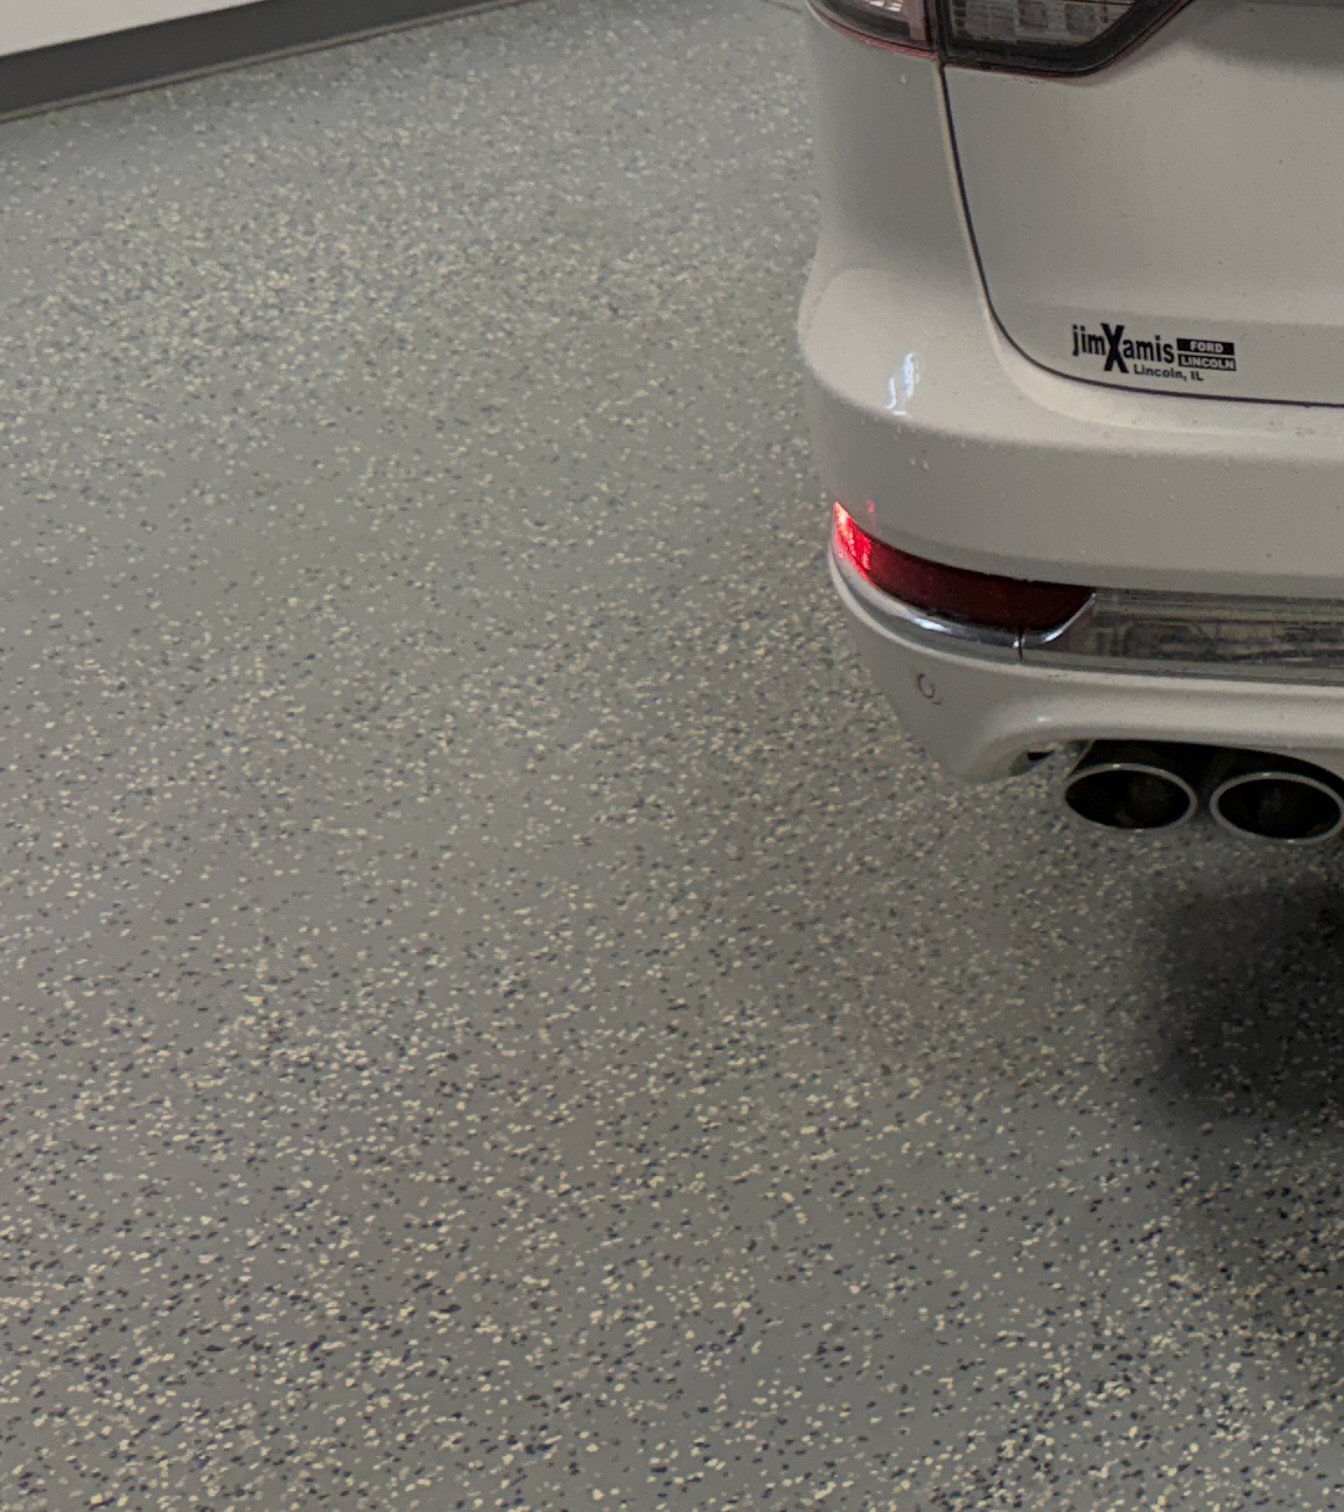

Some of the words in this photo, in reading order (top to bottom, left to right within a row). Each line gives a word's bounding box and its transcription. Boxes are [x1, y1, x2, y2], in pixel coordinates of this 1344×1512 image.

[1190, 342, 1224, 353] FORD
[1180, 357, 1234, 370] LINCOLN
[1134, 364, 1187, 382] Lincoln,
[1190, 371, 1204, 381] IL
